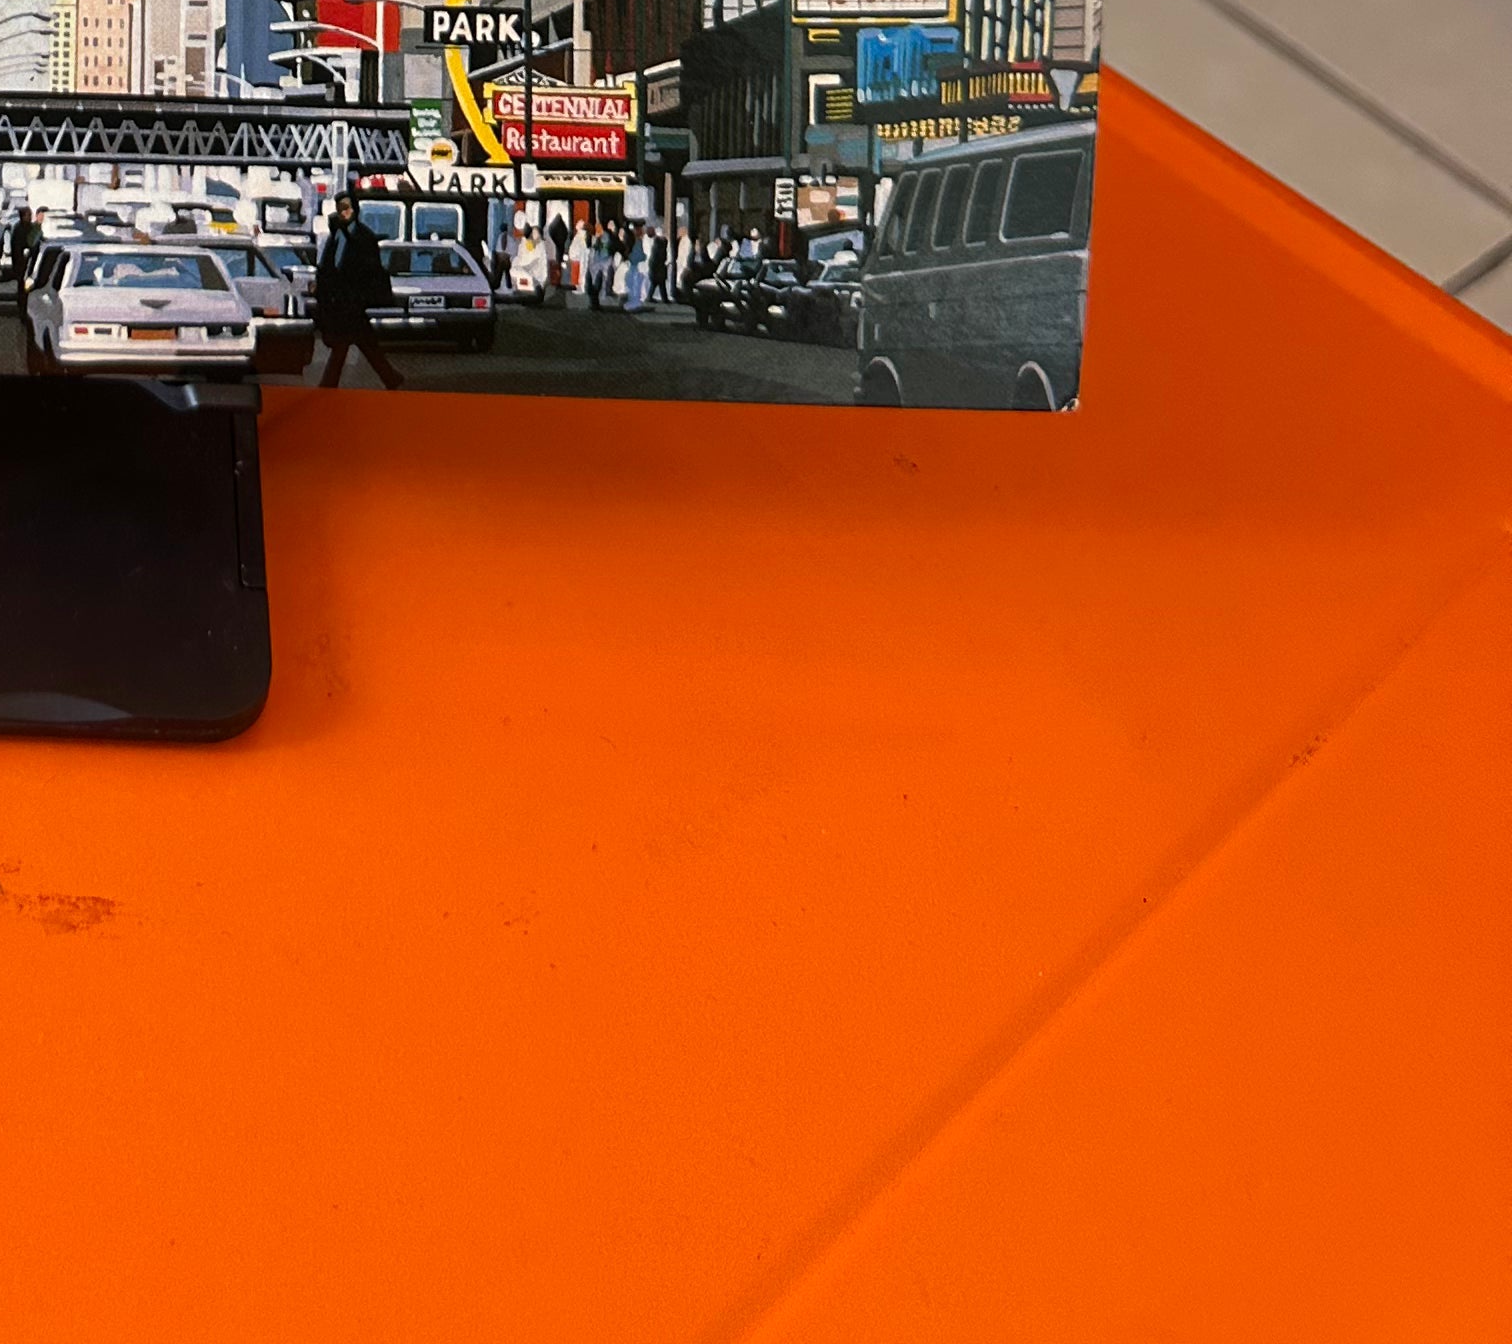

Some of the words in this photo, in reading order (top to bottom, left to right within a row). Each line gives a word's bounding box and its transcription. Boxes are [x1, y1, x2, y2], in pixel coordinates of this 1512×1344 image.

[433, 11, 524, 44] PARK
[505, 125, 622, 158] Restaurant
[428, 168, 513, 196] PARK
